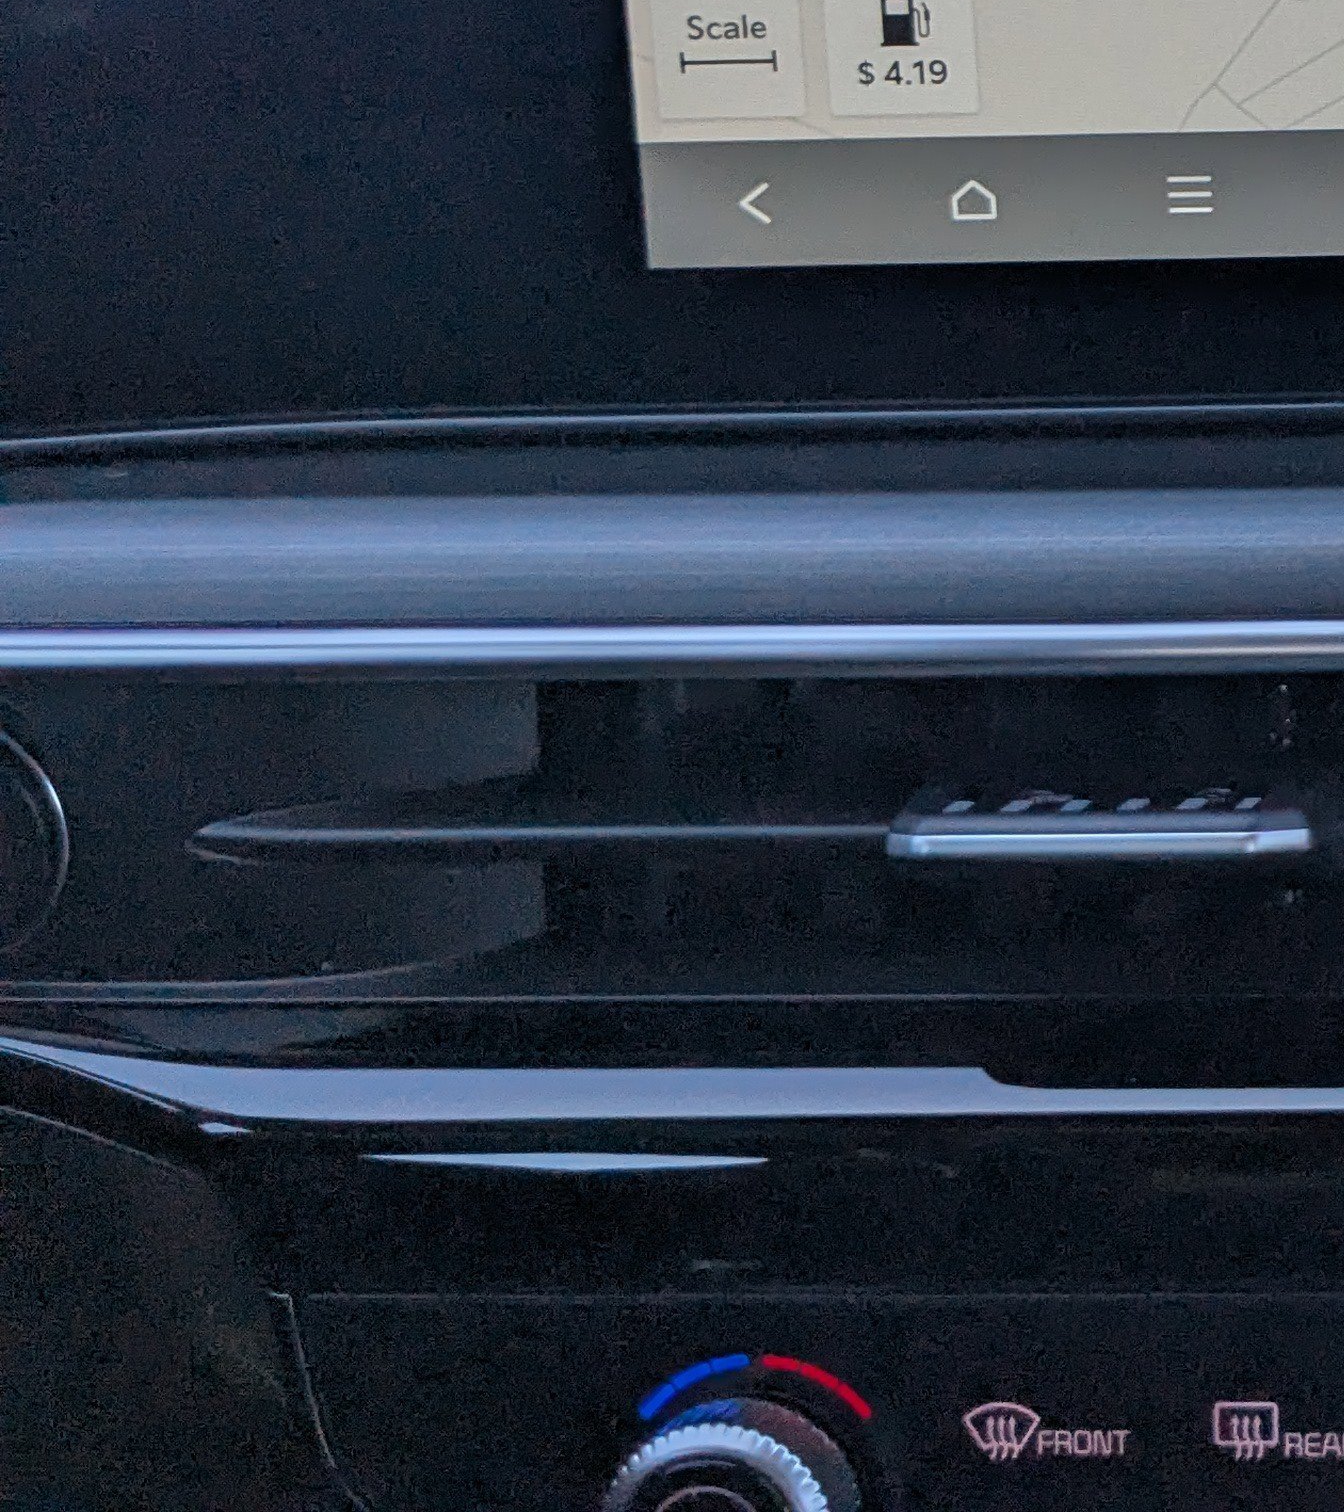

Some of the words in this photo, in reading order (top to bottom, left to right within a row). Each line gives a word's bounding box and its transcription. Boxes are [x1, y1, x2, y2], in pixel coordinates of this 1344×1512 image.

[686, 16, 767, 41] Scale
[857, 62, 877, 88] $
[883, 60, 948, 87] 4.19
[1036, 1428, 1131, 1458] FRONT
